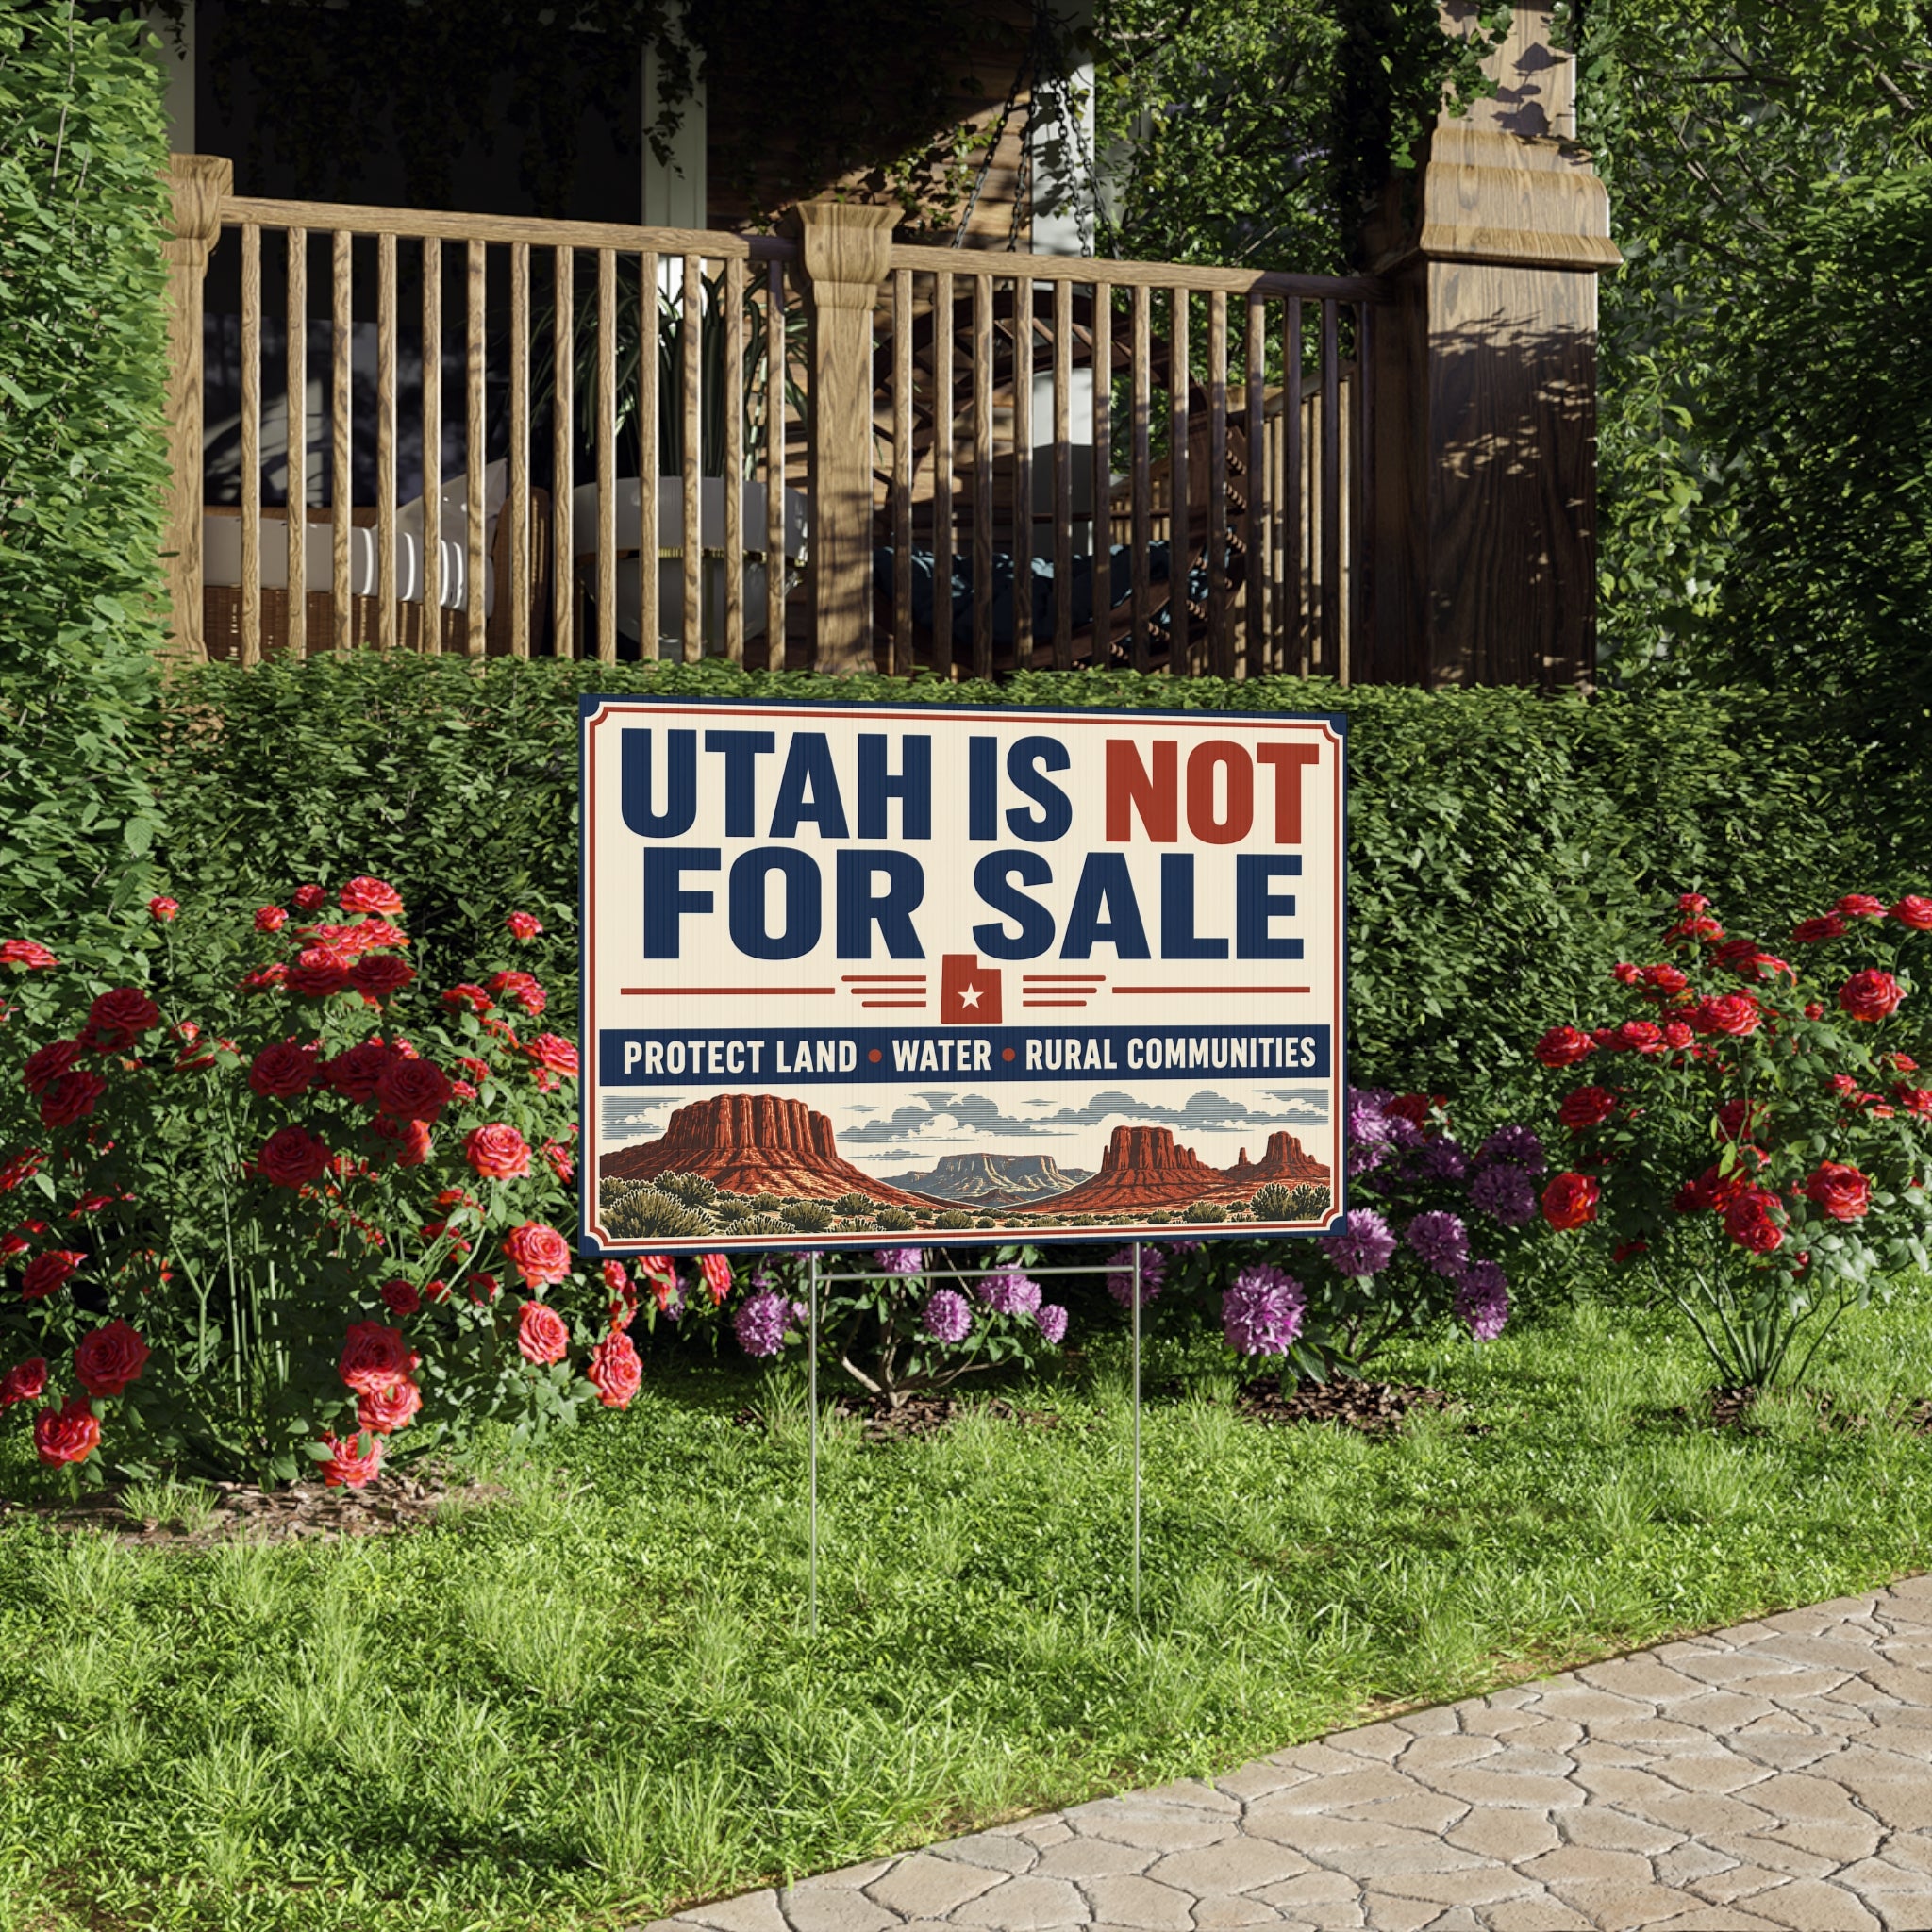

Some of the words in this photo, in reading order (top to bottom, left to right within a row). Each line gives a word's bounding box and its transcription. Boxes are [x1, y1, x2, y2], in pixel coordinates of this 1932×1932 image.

[621, 728, 931, 840] UTAH
[969, 735, 1073, 843] IS
[1105, 739, 1320, 845] NOT
[642, 846, 926, 960] FOR
[972, 848, 1304, 961] SALE
[624, 1040, 766, 1074] PROTECT
[776, 1040, 857, 1073] LAND
[891, 1039, 991, 1072] WATER
[1025, 1038, 1118, 1070] RURAL
[1126, 1036, 1316, 1070] COMMUNITIES
